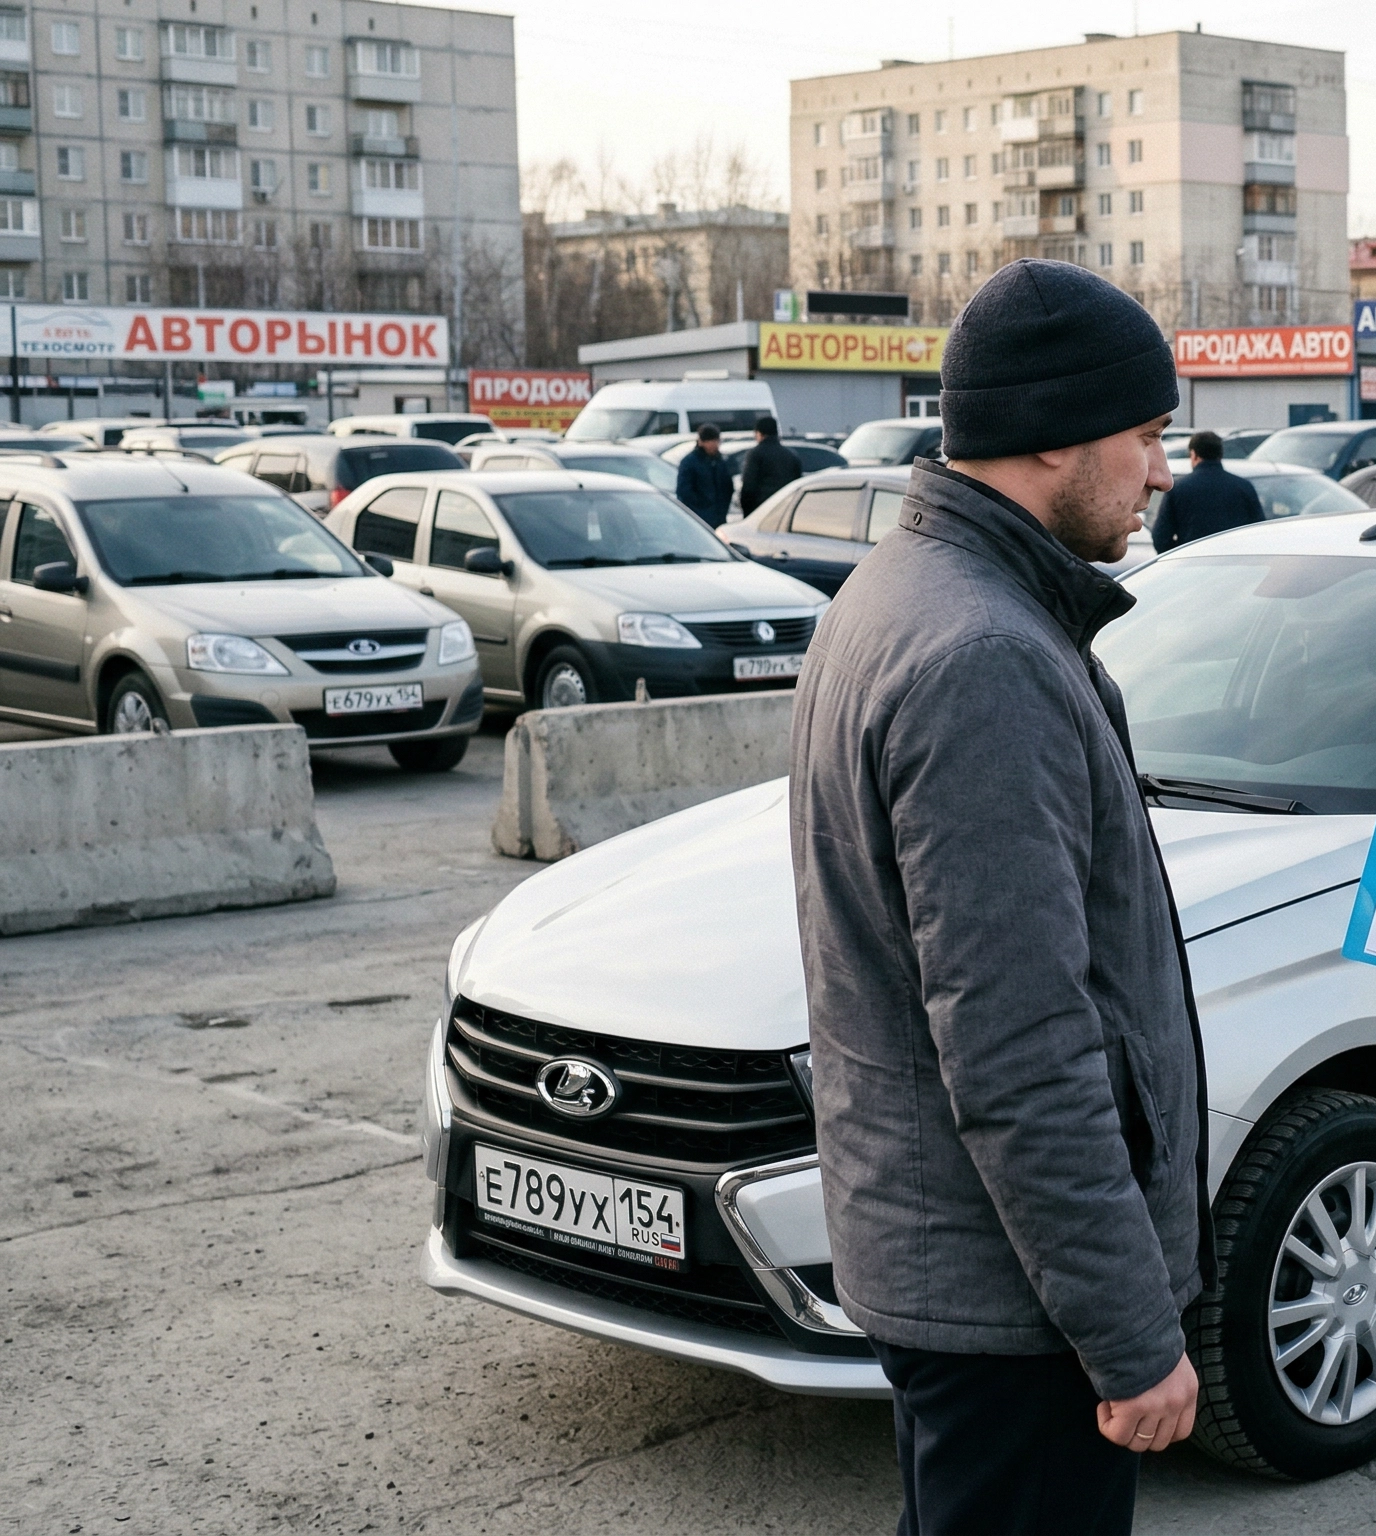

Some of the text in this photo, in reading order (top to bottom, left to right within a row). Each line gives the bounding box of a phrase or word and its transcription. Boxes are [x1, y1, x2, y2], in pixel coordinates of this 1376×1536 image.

[124, 315, 439, 358] АВТОРЫНОК
[1178, 330, 1352, 365] ПРОДАЖА АВТО
[485, 1161, 612, 1235] Е789УХ
[619, 1187, 675, 1233] 154
[631, 1227, 660, 1247] RUS
